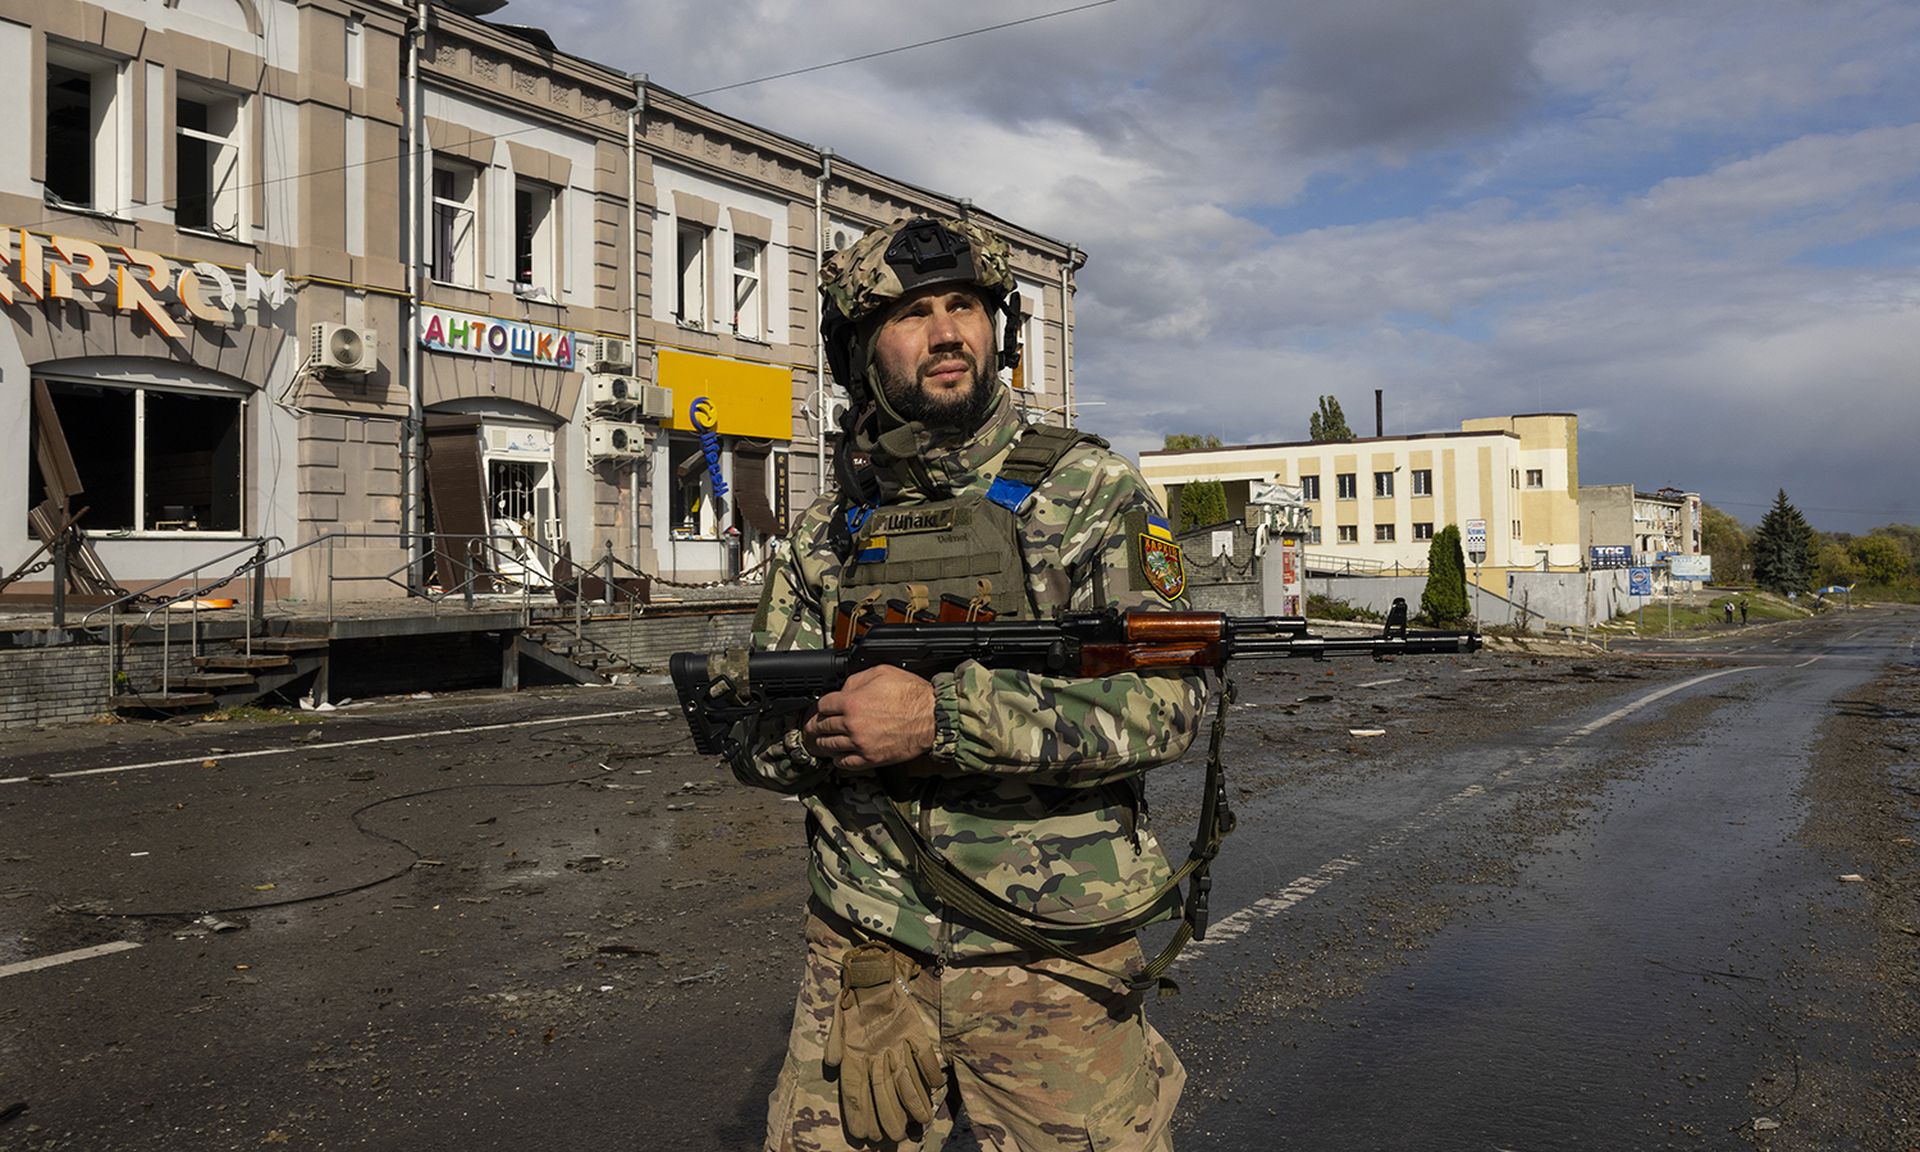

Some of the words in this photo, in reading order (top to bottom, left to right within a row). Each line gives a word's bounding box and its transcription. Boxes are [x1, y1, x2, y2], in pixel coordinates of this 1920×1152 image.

[424, 314, 572, 365] АНТОШКА
[700, 431, 729, 497] lifecell
[888, 513, 937, 530] Шпак
